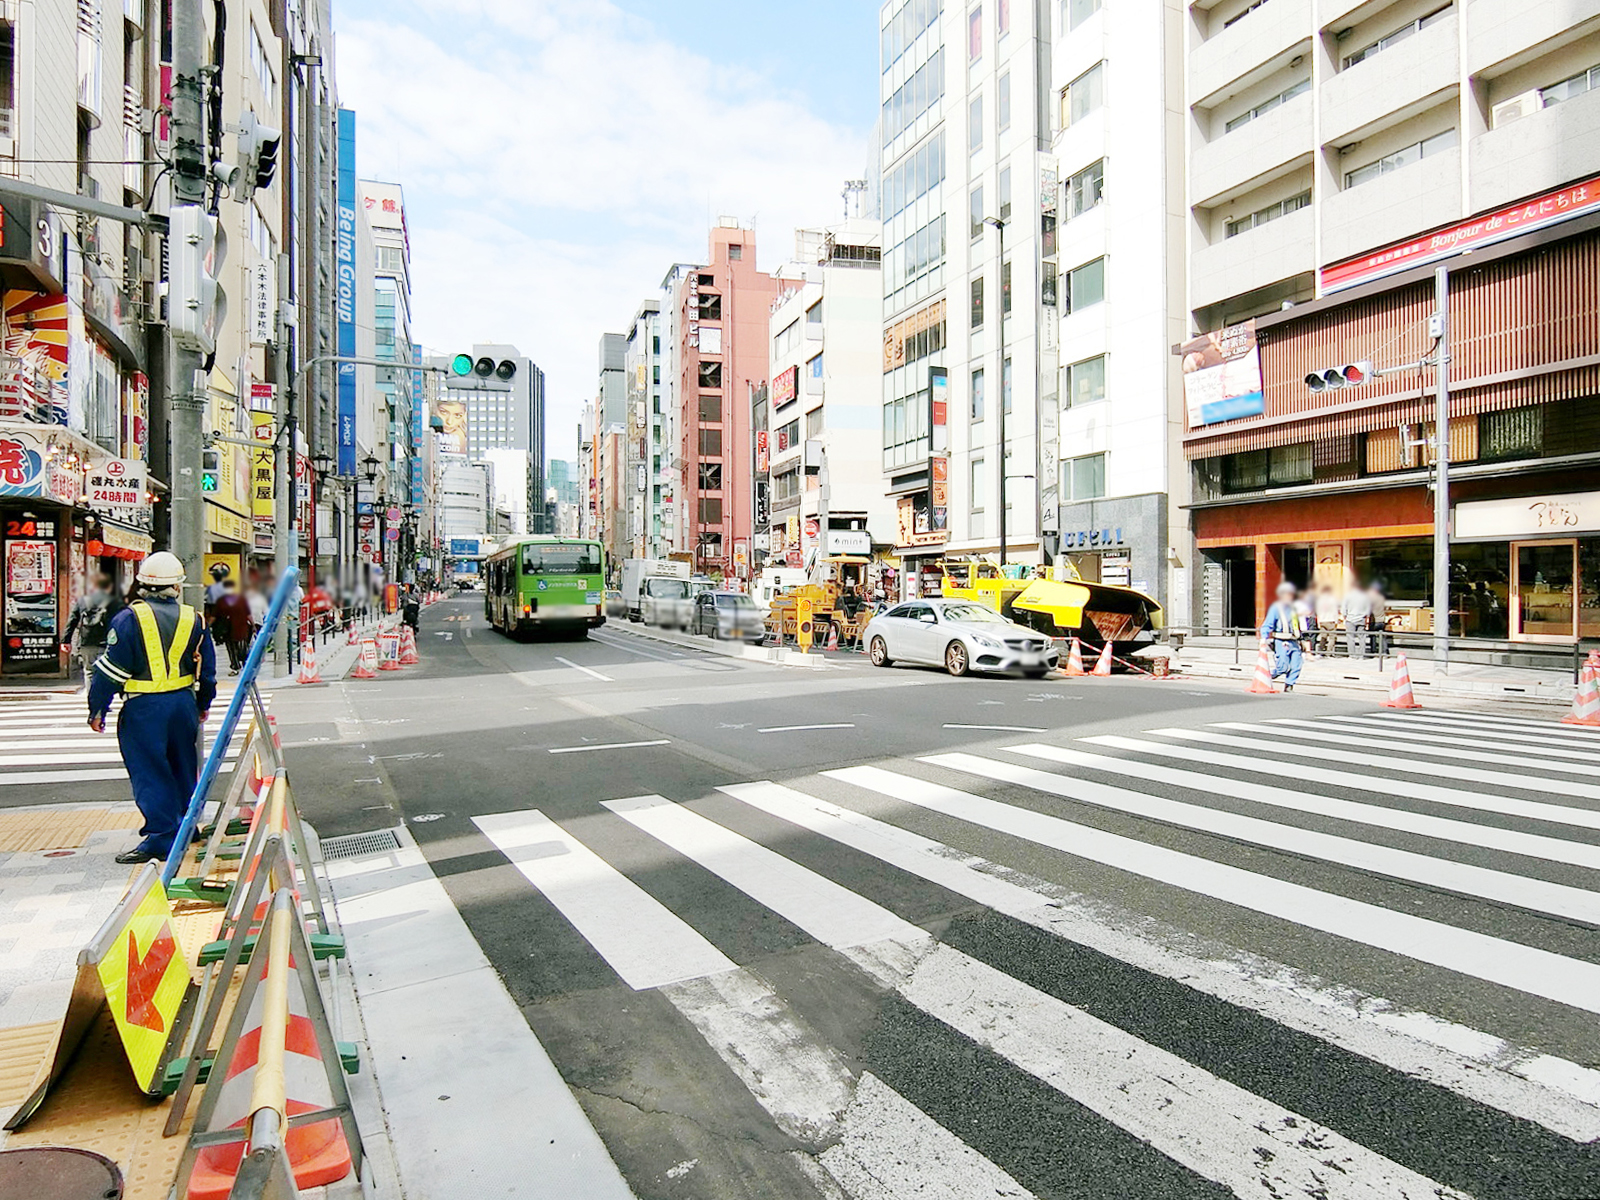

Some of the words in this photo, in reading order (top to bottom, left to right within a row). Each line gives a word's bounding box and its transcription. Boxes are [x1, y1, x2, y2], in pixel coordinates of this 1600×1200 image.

[338, 206, 355, 262] Being
[1429, 225, 1483, 253] Bonjour
[1485, 216, 1503, 231] de
[1508, 187, 1587, 223] こんにちは
[257, 263, 268, 339] 六本木法律事務所
[338, 264, 355, 323] Group
[91, 476, 139, 489] 磯丸水産
[93, 490, 136, 503] 24時間
[255, 451, 271, 499] 大黒屋
